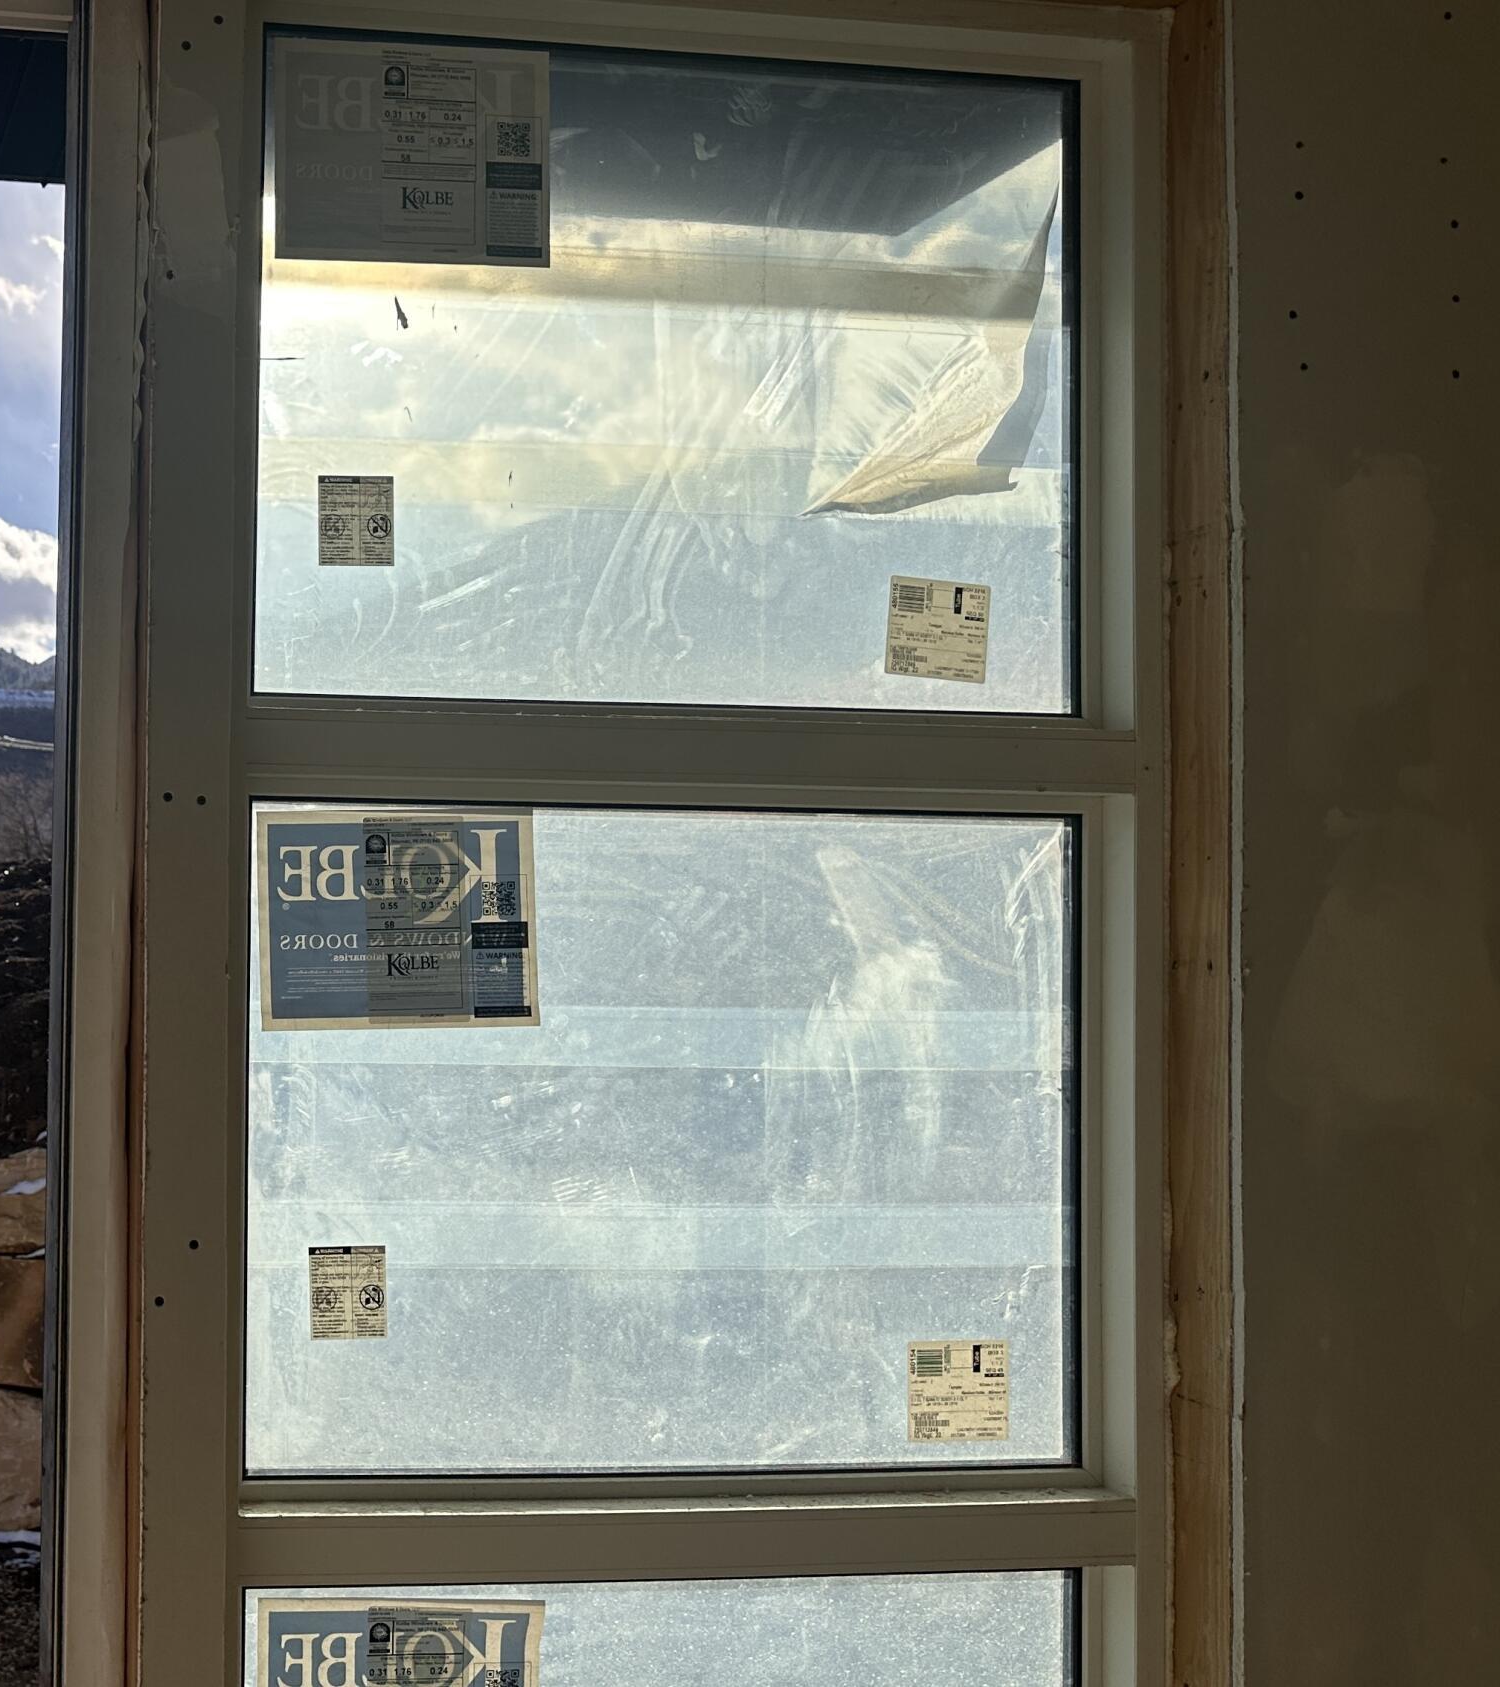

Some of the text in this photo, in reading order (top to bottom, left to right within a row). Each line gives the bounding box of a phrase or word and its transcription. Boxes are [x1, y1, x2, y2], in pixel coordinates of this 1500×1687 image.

[401, 186, 454, 210] KOLBE
[367, 877, 385, 887] 0.31
[426, 876, 445, 886] 0.24
[386, 952, 440, 978] KOLBE
[368, 1666, 448, 1677] 0.31 1.76 0.24
